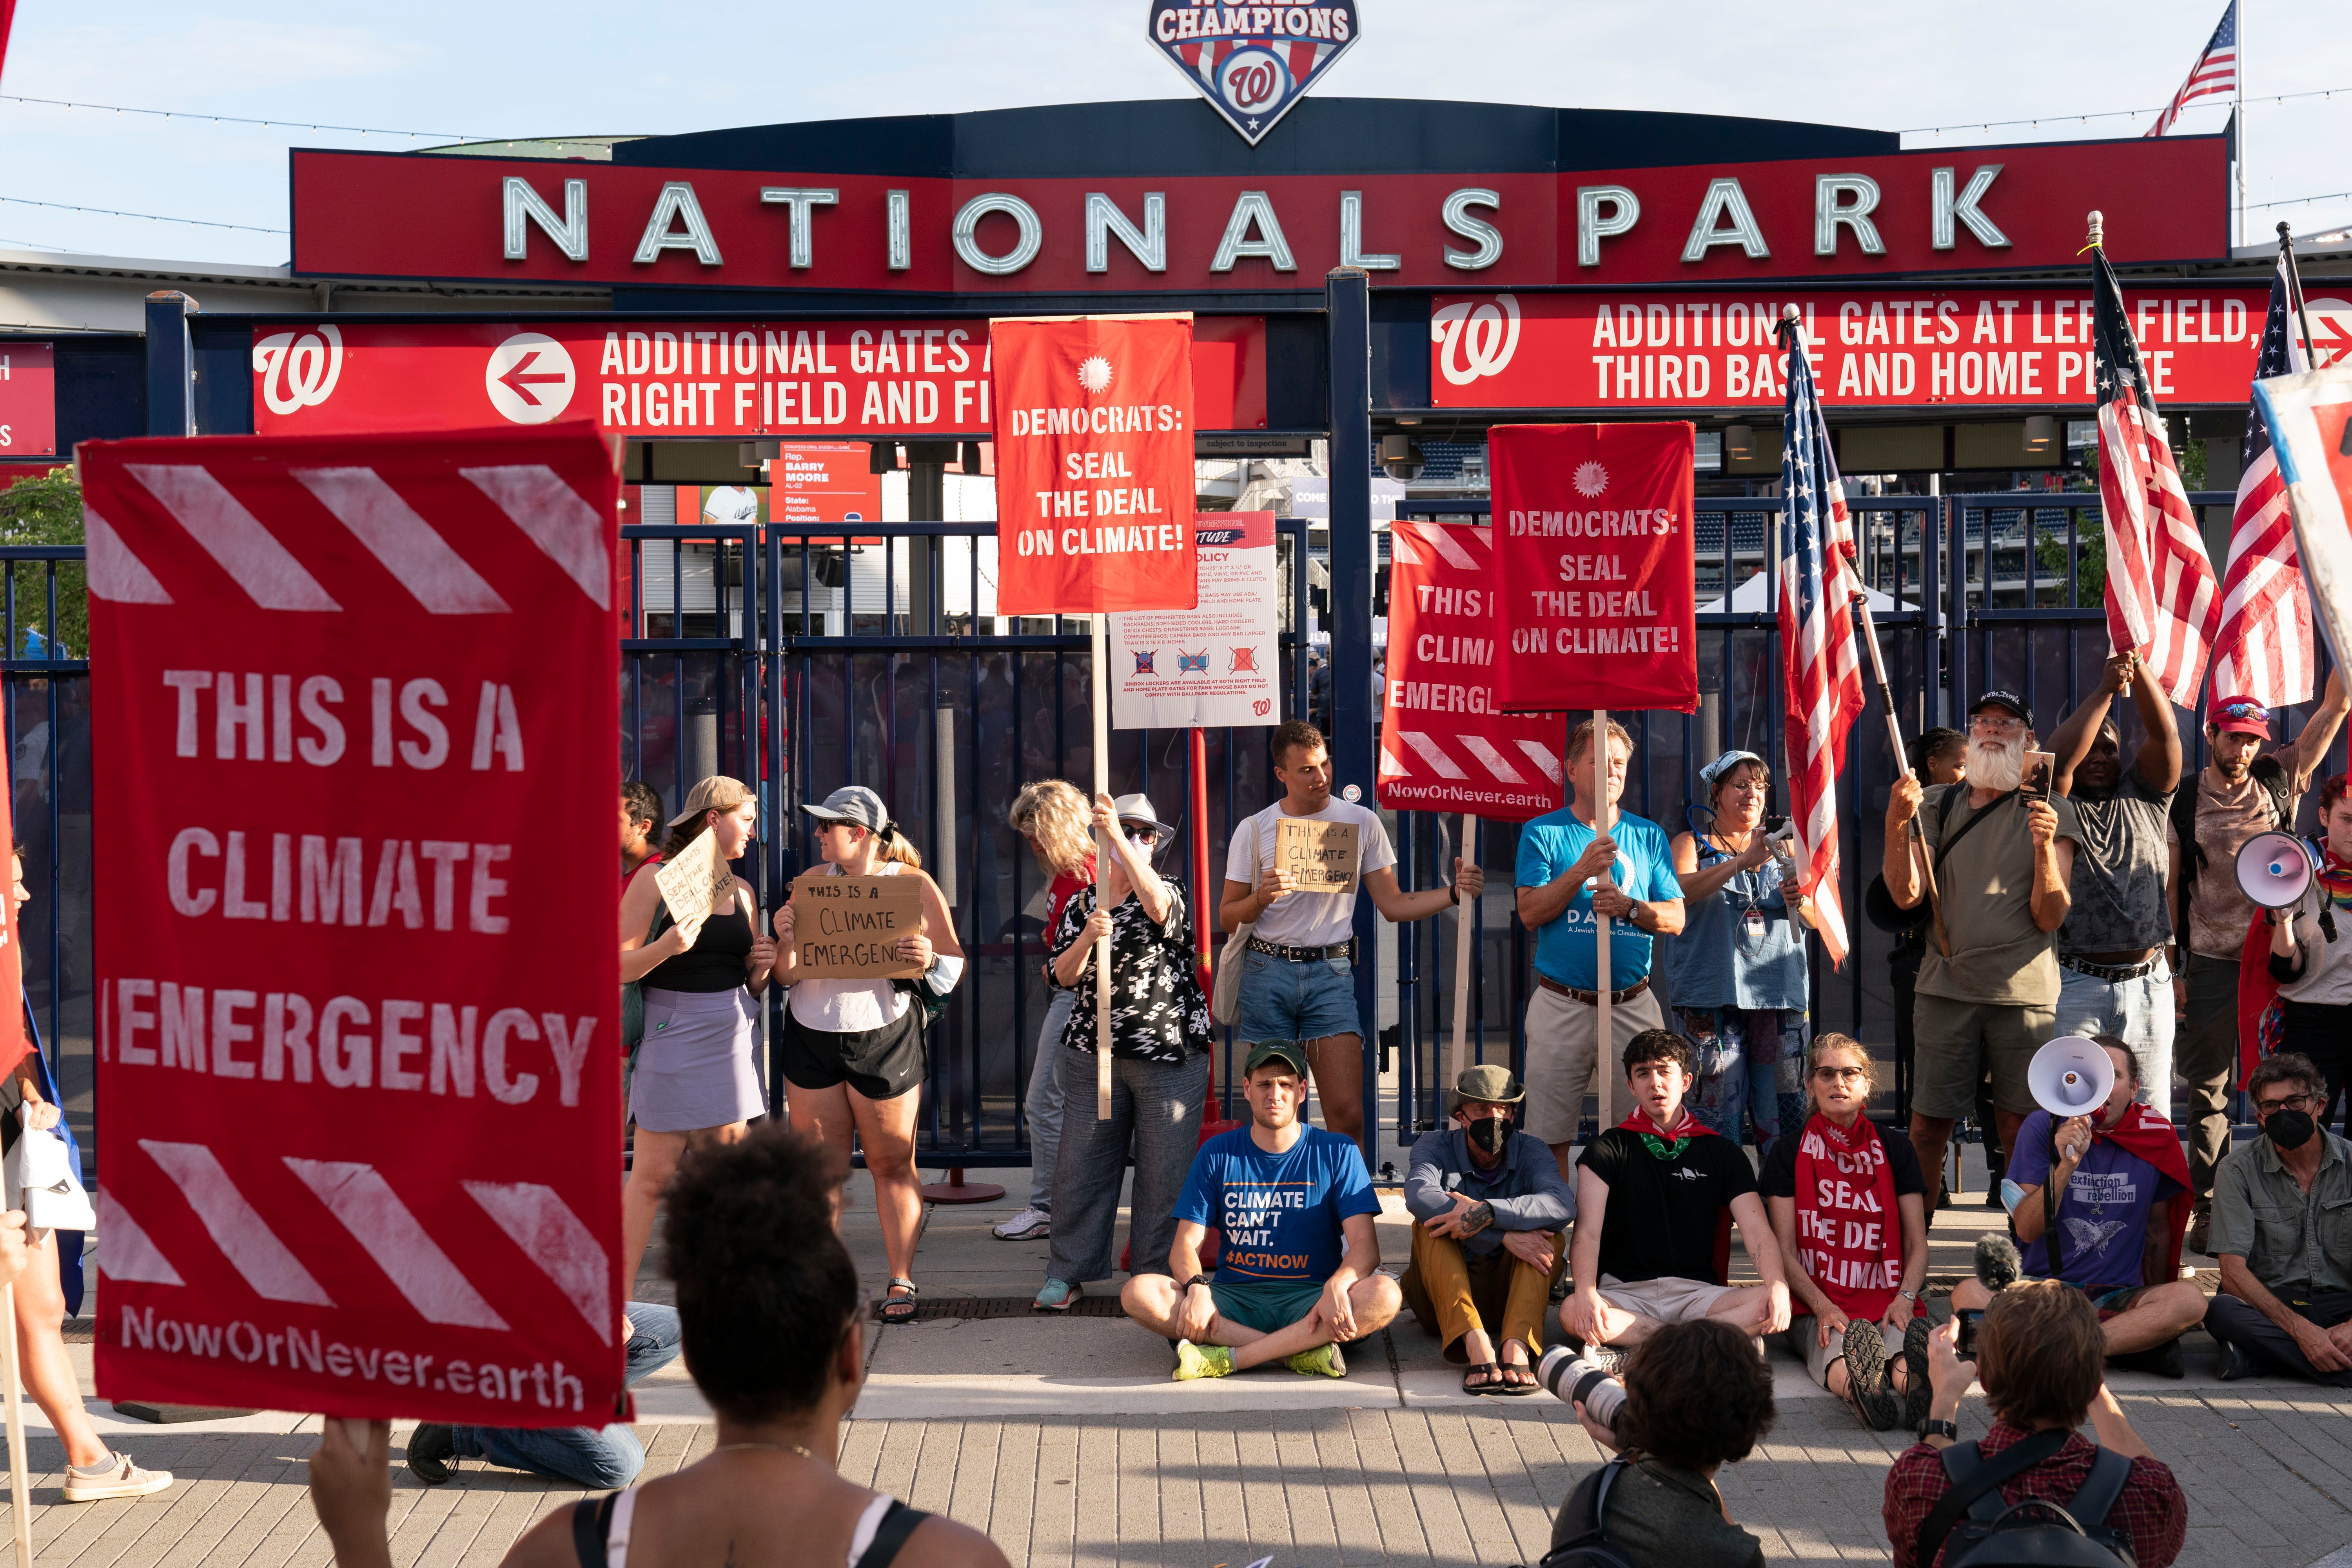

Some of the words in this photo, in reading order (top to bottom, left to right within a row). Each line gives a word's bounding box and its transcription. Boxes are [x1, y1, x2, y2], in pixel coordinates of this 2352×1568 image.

[1157, 8, 1349, 42] CHAMPIONS
[502, 176, 1504, 275] NATIONALS
[1577, 163, 2013, 267] PARK
[1593, 302, 1826, 348] ADDITIONL
[1840, 300, 1960, 346] GATES
[1973, 299, 2019, 344] AT
[2033, 300, 2094, 343] LEF
[2138, 299, 2259, 350] FIELD,
[600, 330, 837, 375] ADDITIONAL
[850, 329, 971, 373] GATES
[1592, 354, 1710, 399] THIRD
[1837, 352, 1915, 397] AND
[1931, 351, 2042, 396] HOME
[603, 382, 720, 427] RIGHT
[735, 381, 846, 426] FIELD
[861, 380, 938, 425] AND
[1012, 405, 1182, 436] DEMOCRATS:
[785, 453, 804, 461] Rep.
[1207, 440, 1234, 448] subject
[786, 463, 824, 471] BARRY
[786, 473, 829, 482] MOORE
[1067, 452, 1132, 480] SEAL
[1036, 489, 1089, 518] THE
[1096, 487, 1162, 516] DEAL
[1296, 492, 1327, 503] COME
[1509, 508, 1678, 537] DEMOCRATS:
[1018, 528, 1054, 557] ON
[1062, 524, 1183, 555] CLIMATE!
[1560, 554, 1627, 581] SEAL
[1418, 585, 1481, 617] THIS
[1532, 591, 1582, 617] THE
[1589, 590, 1657, 617] DEAL
[1512, 627, 1546, 654] ON
[1556, 626, 1678, 654] CLIMATE!
[1999, 691, 2020, 704] People
[163, 670, 347, 768] THIS
[371, 677, 450, 770] IS
[471, 680, 525, 773] A
[1388, 782, 1552, 809] NowOrNever.earth
[1286, 825, 1320, 837] THIS
[1326, 828, 1337, 837] IS
[1341, 828, 1348, 838] A
[1289, 846, 1347, 860] CLIMATE
[167, 827, 512, 934] CLIMATE
[667, 880, 687, 901] SEAL
[687, 863, 704, 881] THE
[1291, 864, 1354, 883] EMERGENCY
[676, 887, 702, 910] DEAL
[702, 869, 715, 886] ON
[694, 871, 733, 914] CLIMATE!
[808, 886, 841, 898] THIS
[848, 886, 860, 898] IS
[869, 887, 878, 898] A
[820, 908, 895, 936] CLIMATE
[804, 942, 914, 967] EMERGENC
[118, 978, 598, 1108] EMERGENCY
[2071, 1174, 2120, 1187] extinction
[2087, 1187, 2133, 1201] rebellion
[1225, 1191, 1304, 1209] CLIMATE
[1818, 1179, 1883, 1212] SEAL
[1227, 1230, 1274, 1246] WAIT.
[1798, 1210, 1836, 1247] THE
[1226, 1250, 1309, 1269] #ACTNOW
[121, 1304, 585, 1411] NowOrNever.earth
